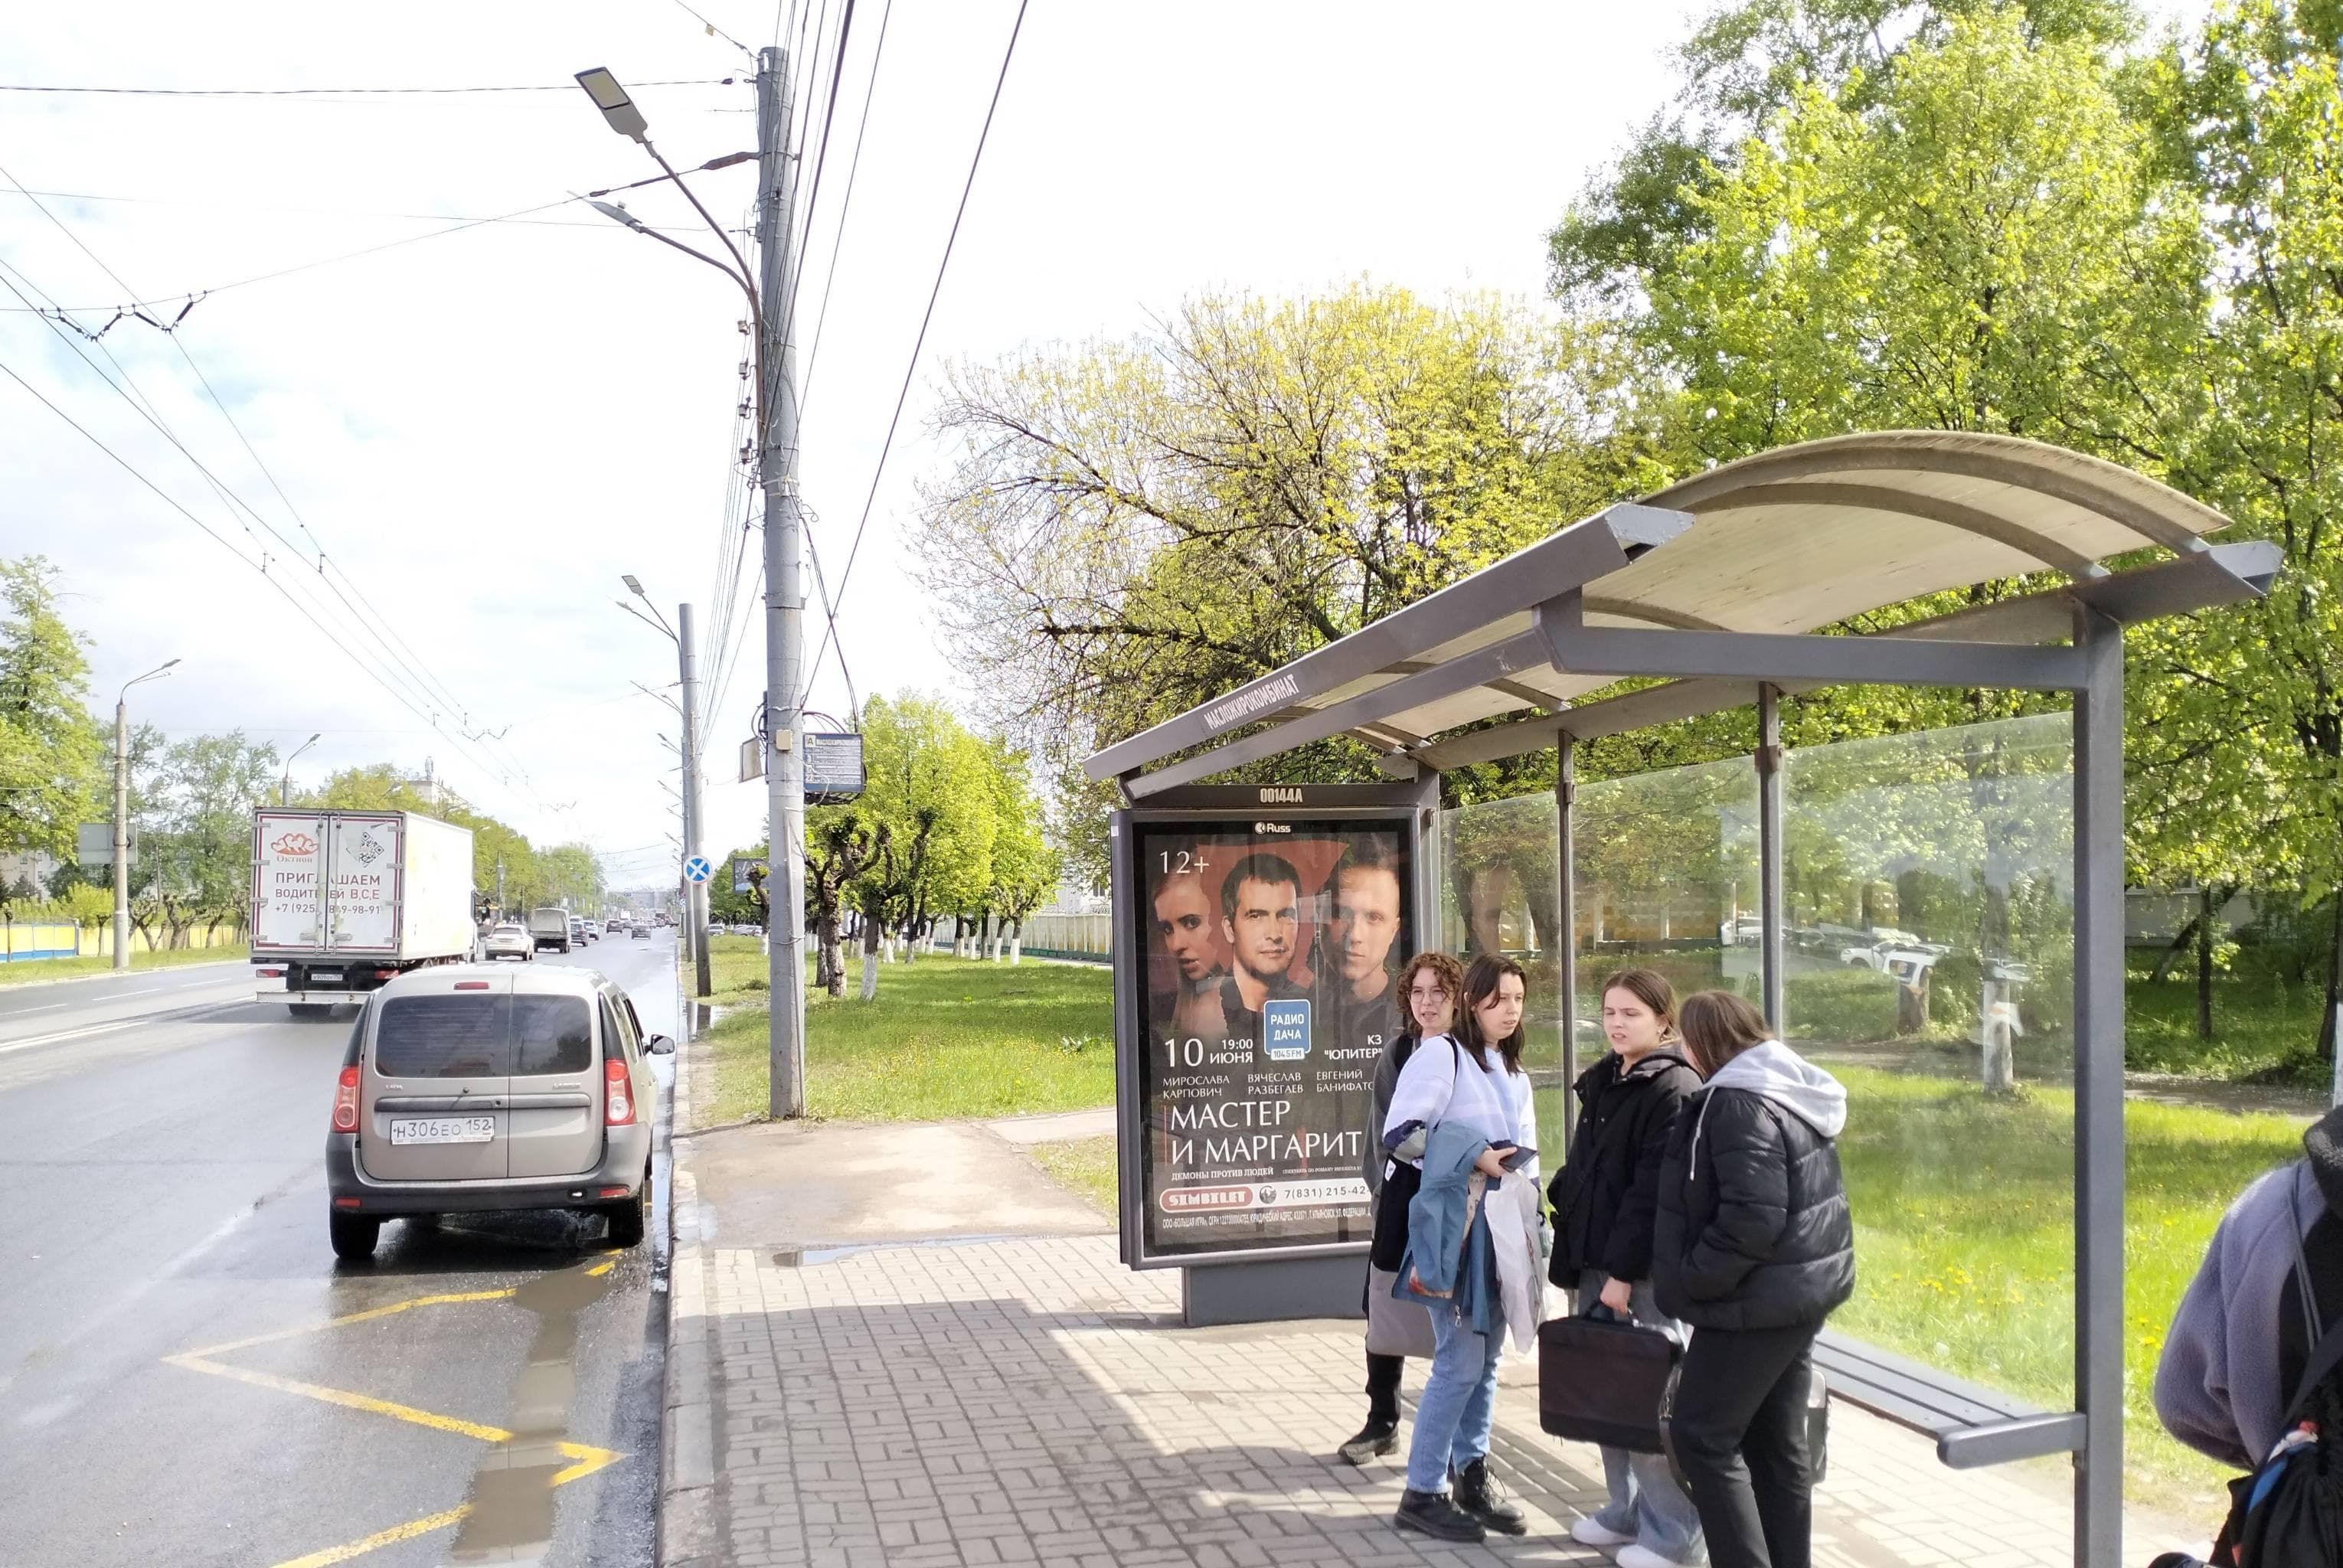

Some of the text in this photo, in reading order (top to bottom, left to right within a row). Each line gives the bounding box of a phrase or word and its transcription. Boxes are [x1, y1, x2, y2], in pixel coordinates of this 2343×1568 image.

[1204, 674, 1299, 730] МАСЛОЖИРОКОМБИНАТ
[1266, 823, 1291, 834] Russ
[1159, 850, 1210, 874] 12+
[276, 873, 381, 886] ПРИГШАЕМ
[276, 904, 288, 913] +7
[292, 903, 316, 913] (925
[1270, 1014, 1305, 1025] РАДИО
[1273, 1029, 1302, 1040] ДАЧА
[1368, 1035, 1382, 1045] КЗ
[1221, 1038, 1253, 1050] 19:00
[1165, 1038, 1204, 1067] 10
[1210, 1051, 1253, 1064] ИЮНЯ
[1324, 1047, 1382, 1060] "ЮПИТЕР"
[1247, 1073, 1301, 1083] ВЯЧЕСЛАВ
[1316, 1068, 1363, 1080] ЕВГЕНИЙ
[1163, 1075, 1230, 1086] МИРОСЛАВА
[1163, 1087, 1222, 1099] КАРПОВИЧ
[1248, 1084, 1303, 1096] РАЗБЕГАЕВ
[1316, 1081, 1374, 1093] БАНИФАТО
[1171, 1100, 1291, 1130] МАСТЕР
[1172, 1131, 1362, 1165] И МАРГАРИТ
[1172, 1166, 1274, 1181] ДЕМОНЫ ПРОТИВ ЛЮДЕЙ
[1285, 1185, 1369, 1199] 7(831) 215-42-
[1169, 1191, 1246, 1207] SIMBILET
